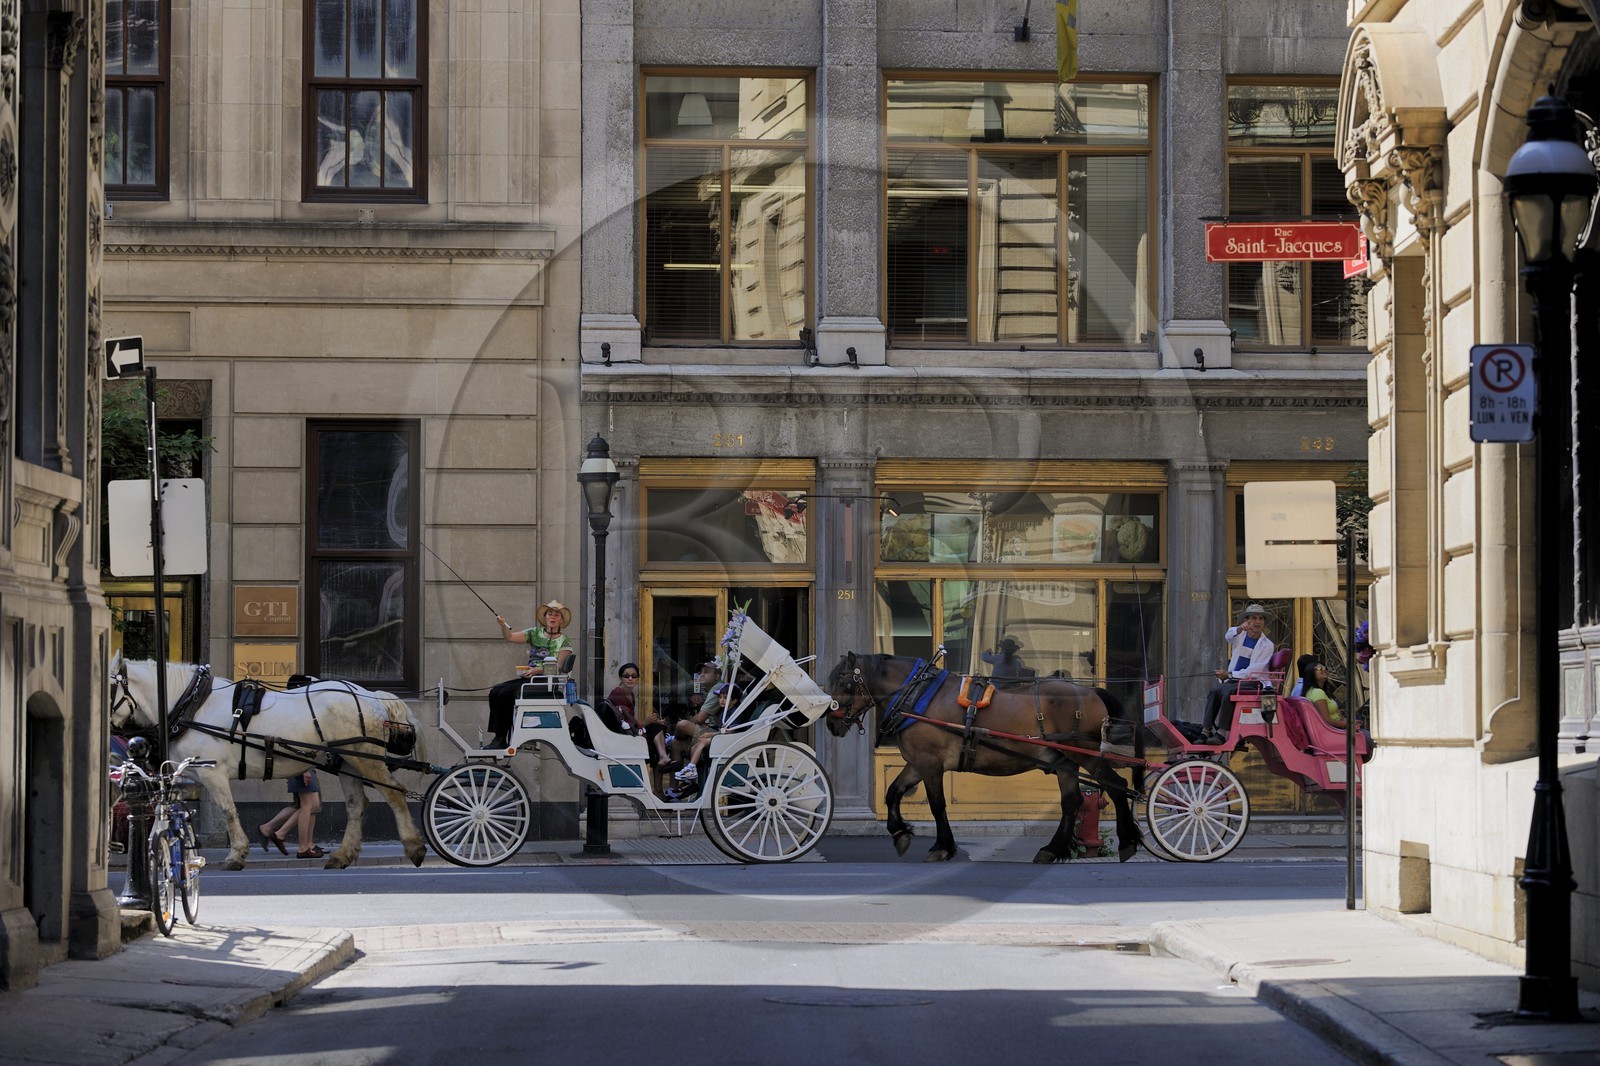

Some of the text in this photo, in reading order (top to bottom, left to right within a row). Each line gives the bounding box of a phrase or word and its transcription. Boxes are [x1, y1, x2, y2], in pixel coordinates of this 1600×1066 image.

[1274, 228, 1293, 237] Rue
[1225, 238, 1342, 258] Saint-Jacques
[1480, 396, 1495, 409] 8h
[1477, 411, 1495, 424] LUN
[1510, 411, 1529, 424] VEN
[837, 589, 855, 600] 251
[243, 601, 289, 616] GTI
[263, 615, 291, 623] Capital
[237, 661, 294, 676] SOLIM
